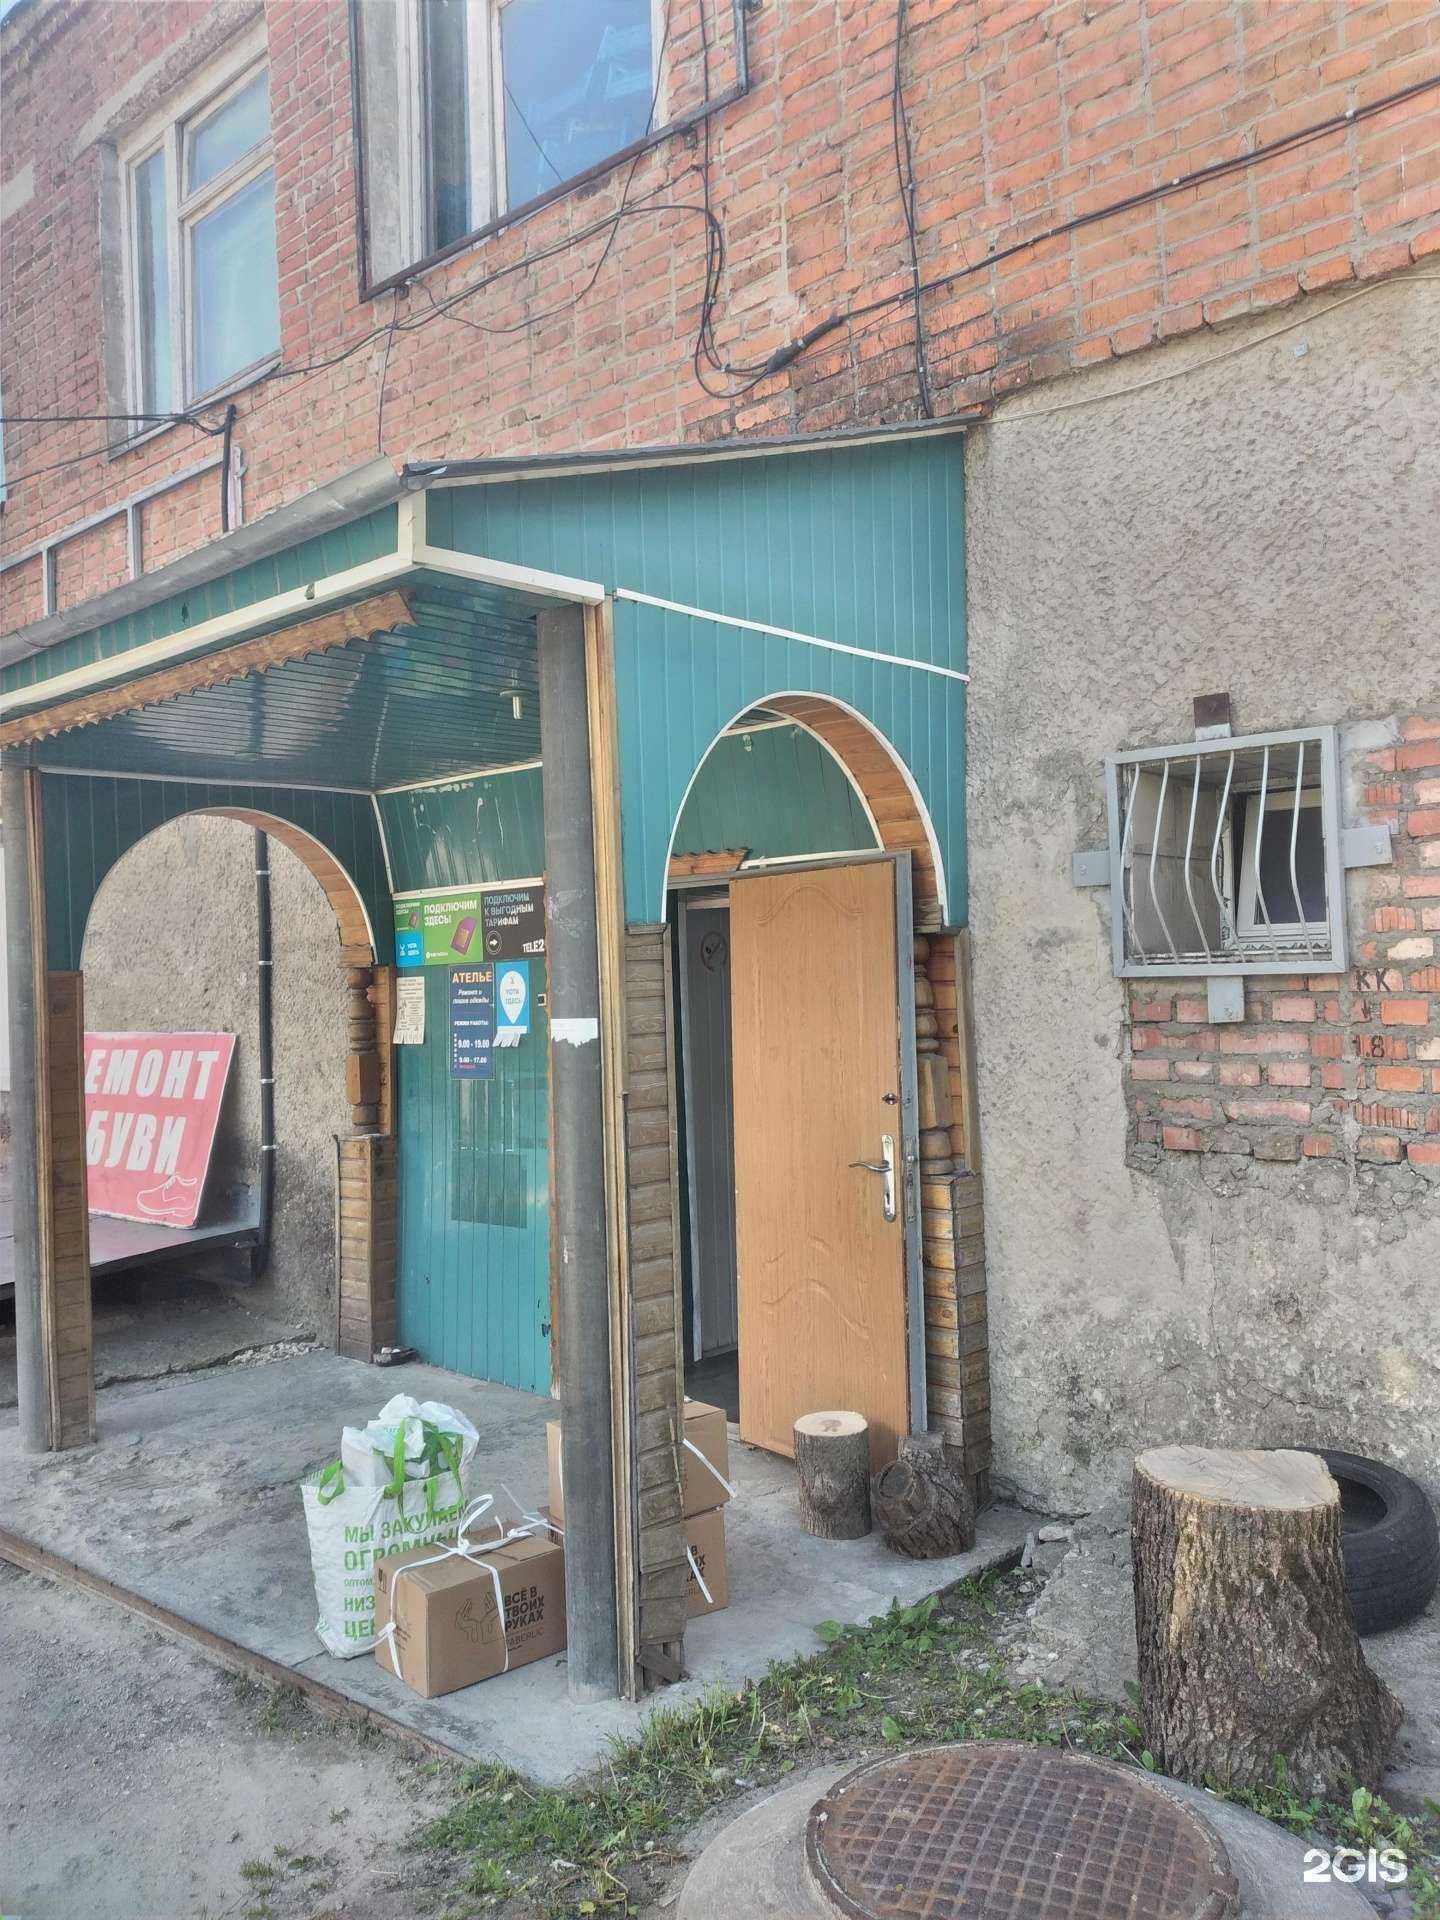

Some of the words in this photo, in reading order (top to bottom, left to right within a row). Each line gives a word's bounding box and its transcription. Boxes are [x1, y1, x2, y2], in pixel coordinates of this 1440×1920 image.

[485, 892, 530, 906] ПОДКЛЮЧИМ
[424, 900, 478, 914] ПОДКЛЮЧИМ
[491, 903, 534, 916] ВЫГОДНЫМ
[485, 915, 519, 928] ТАРИФАМ
[522, 938, 545, 953] TELE2
[452, 971, 492, 984] АТЕЛЬЕ
[85, 1049, 220, 1100] ЕМОНТ
[87, 1110, 187, 1176] БУВИ
[344, 1525, 375, 1543] МЫ
[530, 1586, 537, 1598] В
[344, 1595, 376, 1612] НИЗ
[504, 1595, 545, 1619] ТВОИХ
[504, 1608, 544, 1632] РУКАХ
